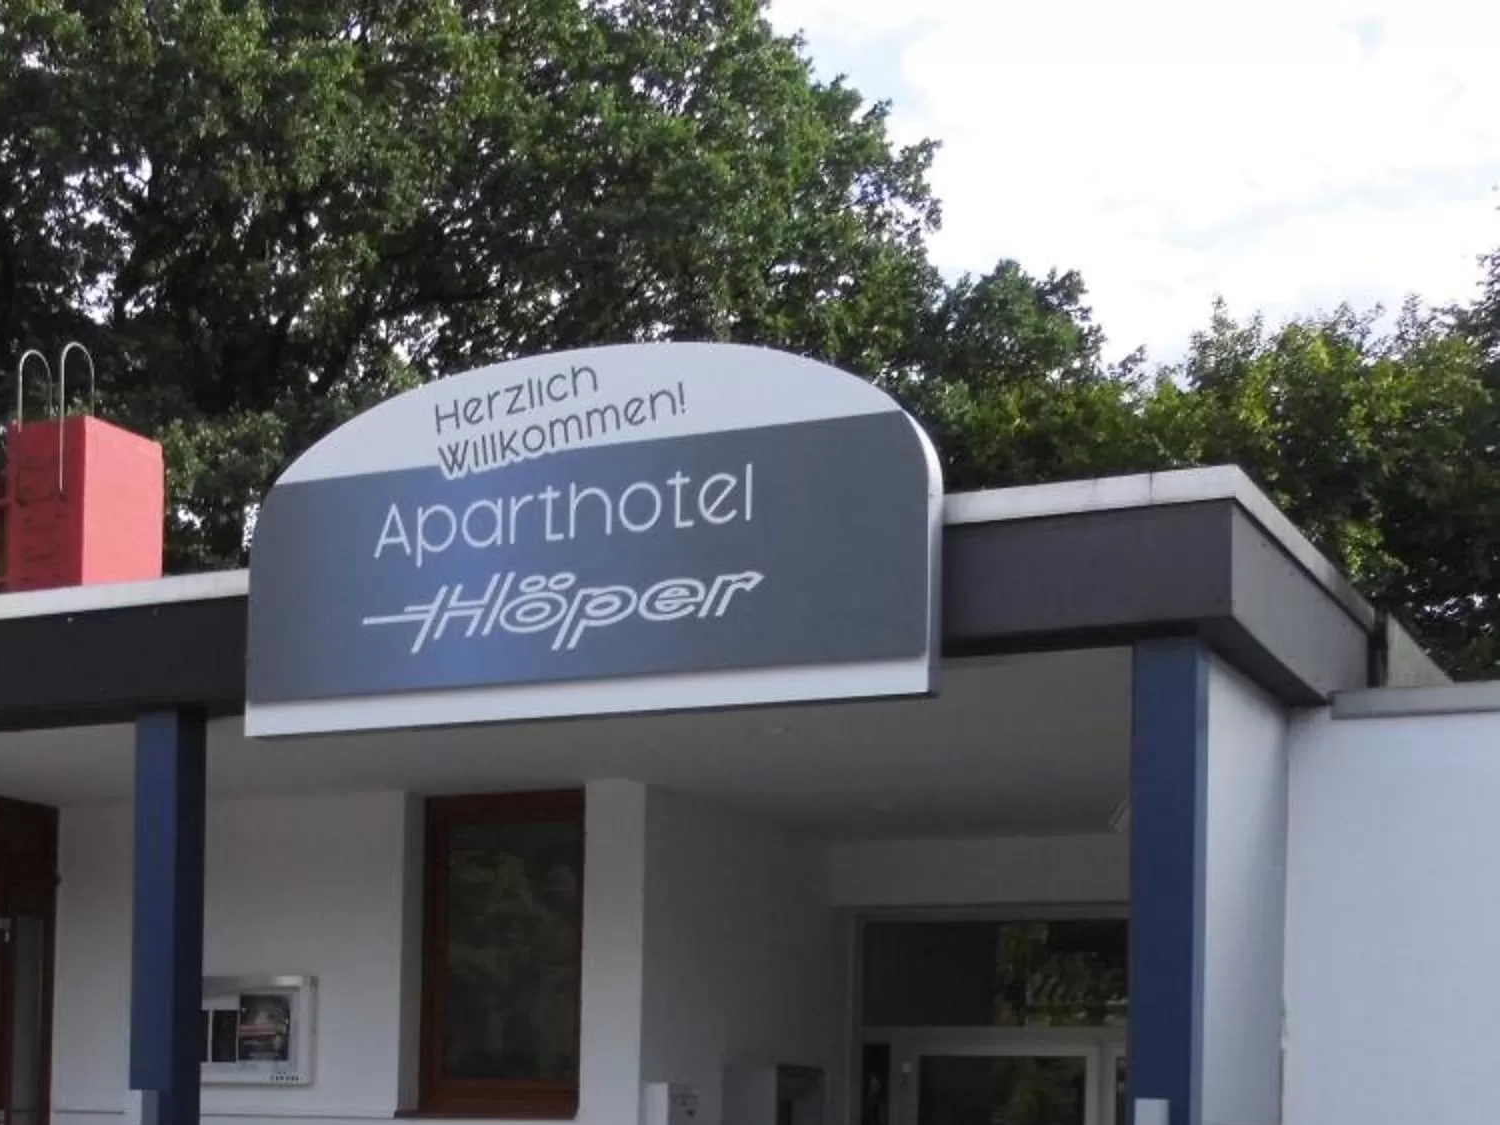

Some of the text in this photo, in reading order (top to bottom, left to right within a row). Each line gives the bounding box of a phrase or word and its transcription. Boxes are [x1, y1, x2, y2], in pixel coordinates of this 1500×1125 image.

[434, 365, 599, 435] Herzlich
[437, 381, 687, 479] Willkommen!
[373, 462, 755, 569] Aparthotel
[361, 570, 766, 655] Höper
